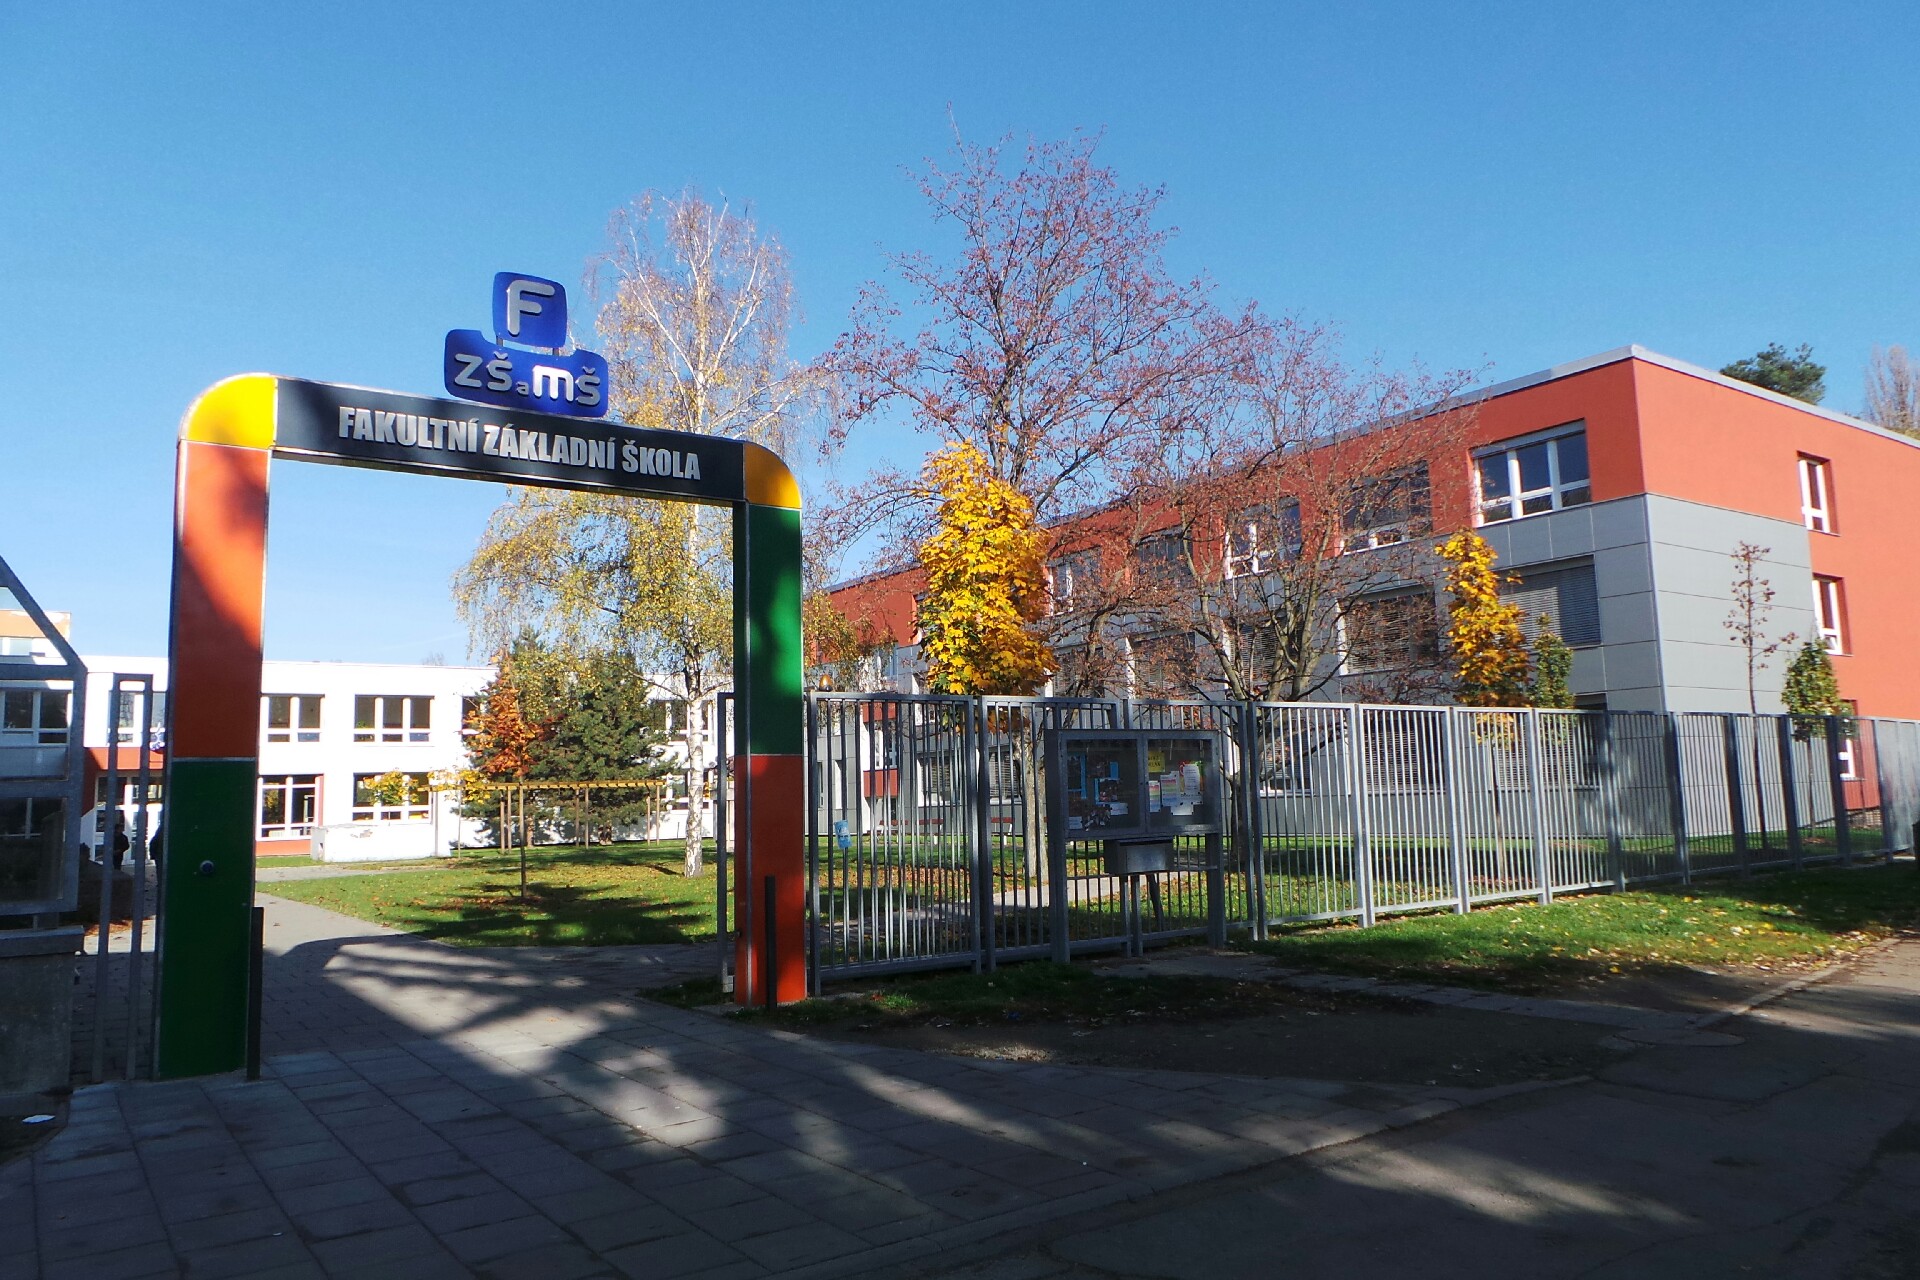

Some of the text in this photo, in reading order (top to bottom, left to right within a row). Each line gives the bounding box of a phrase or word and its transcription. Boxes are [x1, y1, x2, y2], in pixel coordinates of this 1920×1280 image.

[507, 279, 556, 336] F
[338, 406, 701, 480] FAKULTNÍ ZÁKLADNÍ ŠKOLA
